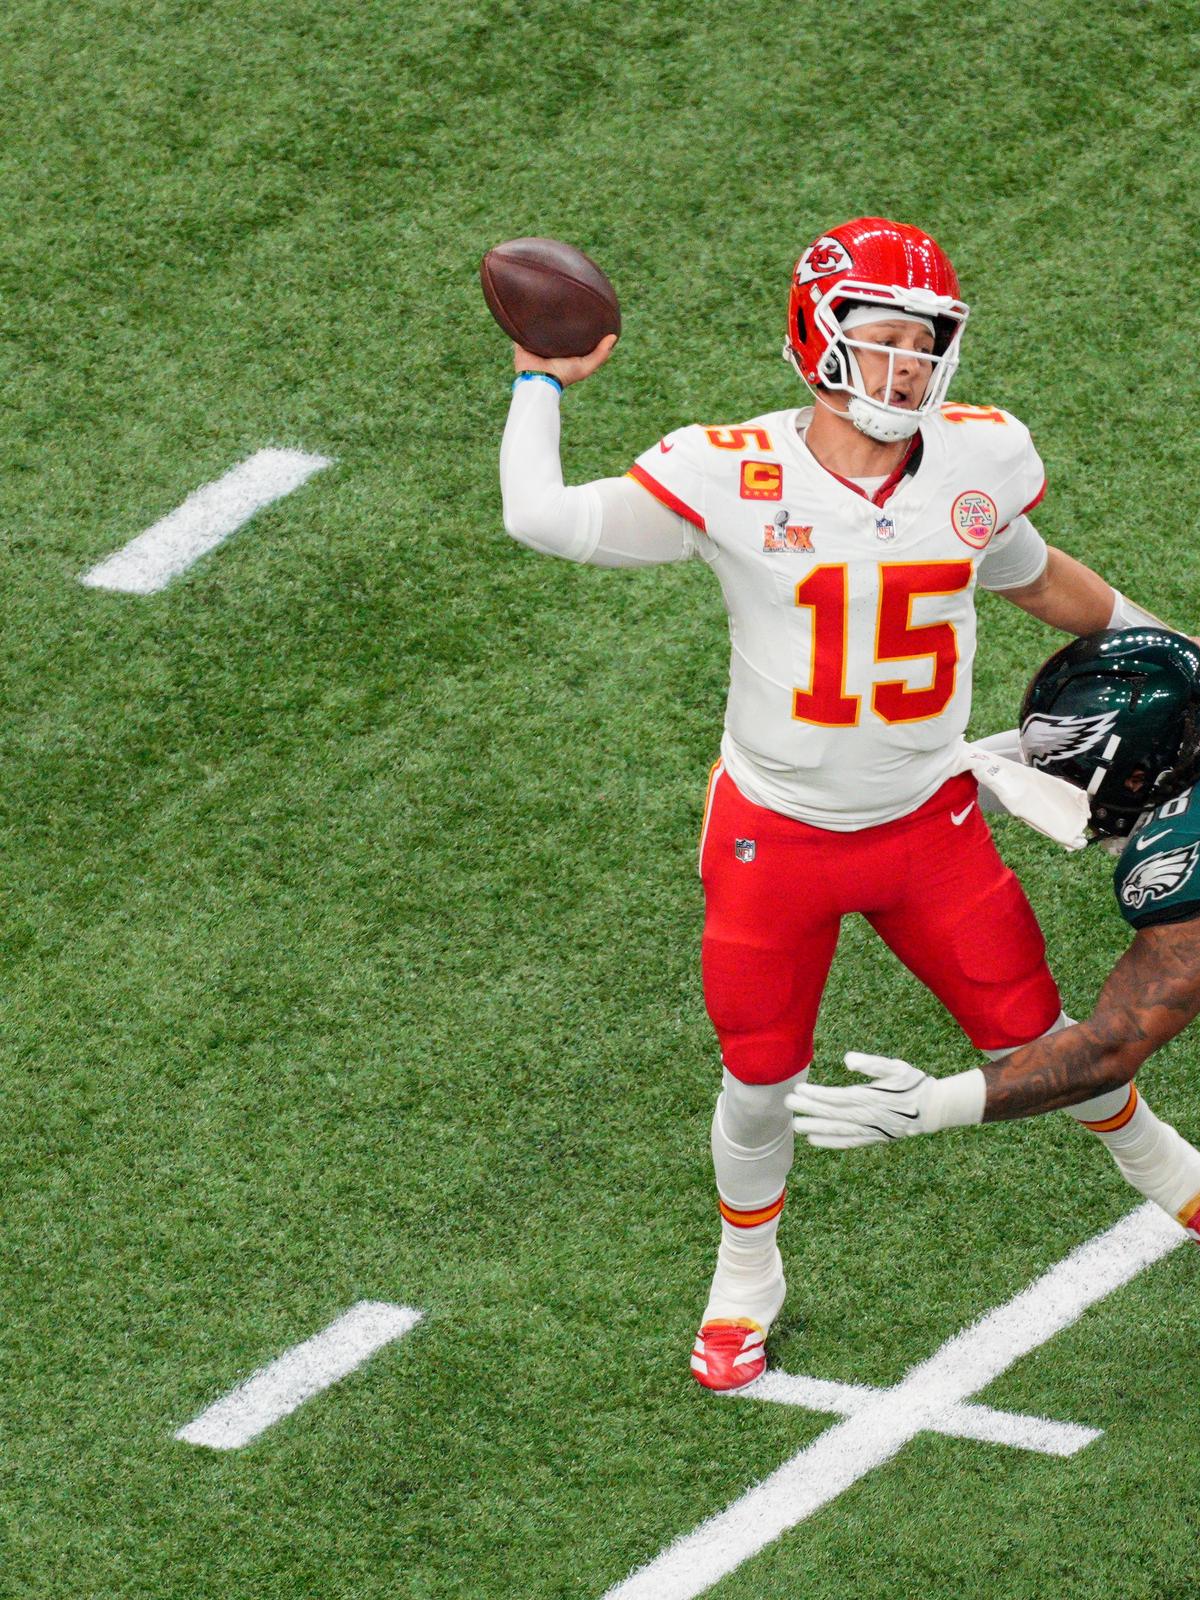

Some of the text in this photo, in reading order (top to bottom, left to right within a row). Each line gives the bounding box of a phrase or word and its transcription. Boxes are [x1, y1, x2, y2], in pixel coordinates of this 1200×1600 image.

[805, 244, 844, 273] KC
[744, 463, 780, 490] C
[791, 559, 974, 728] 15
